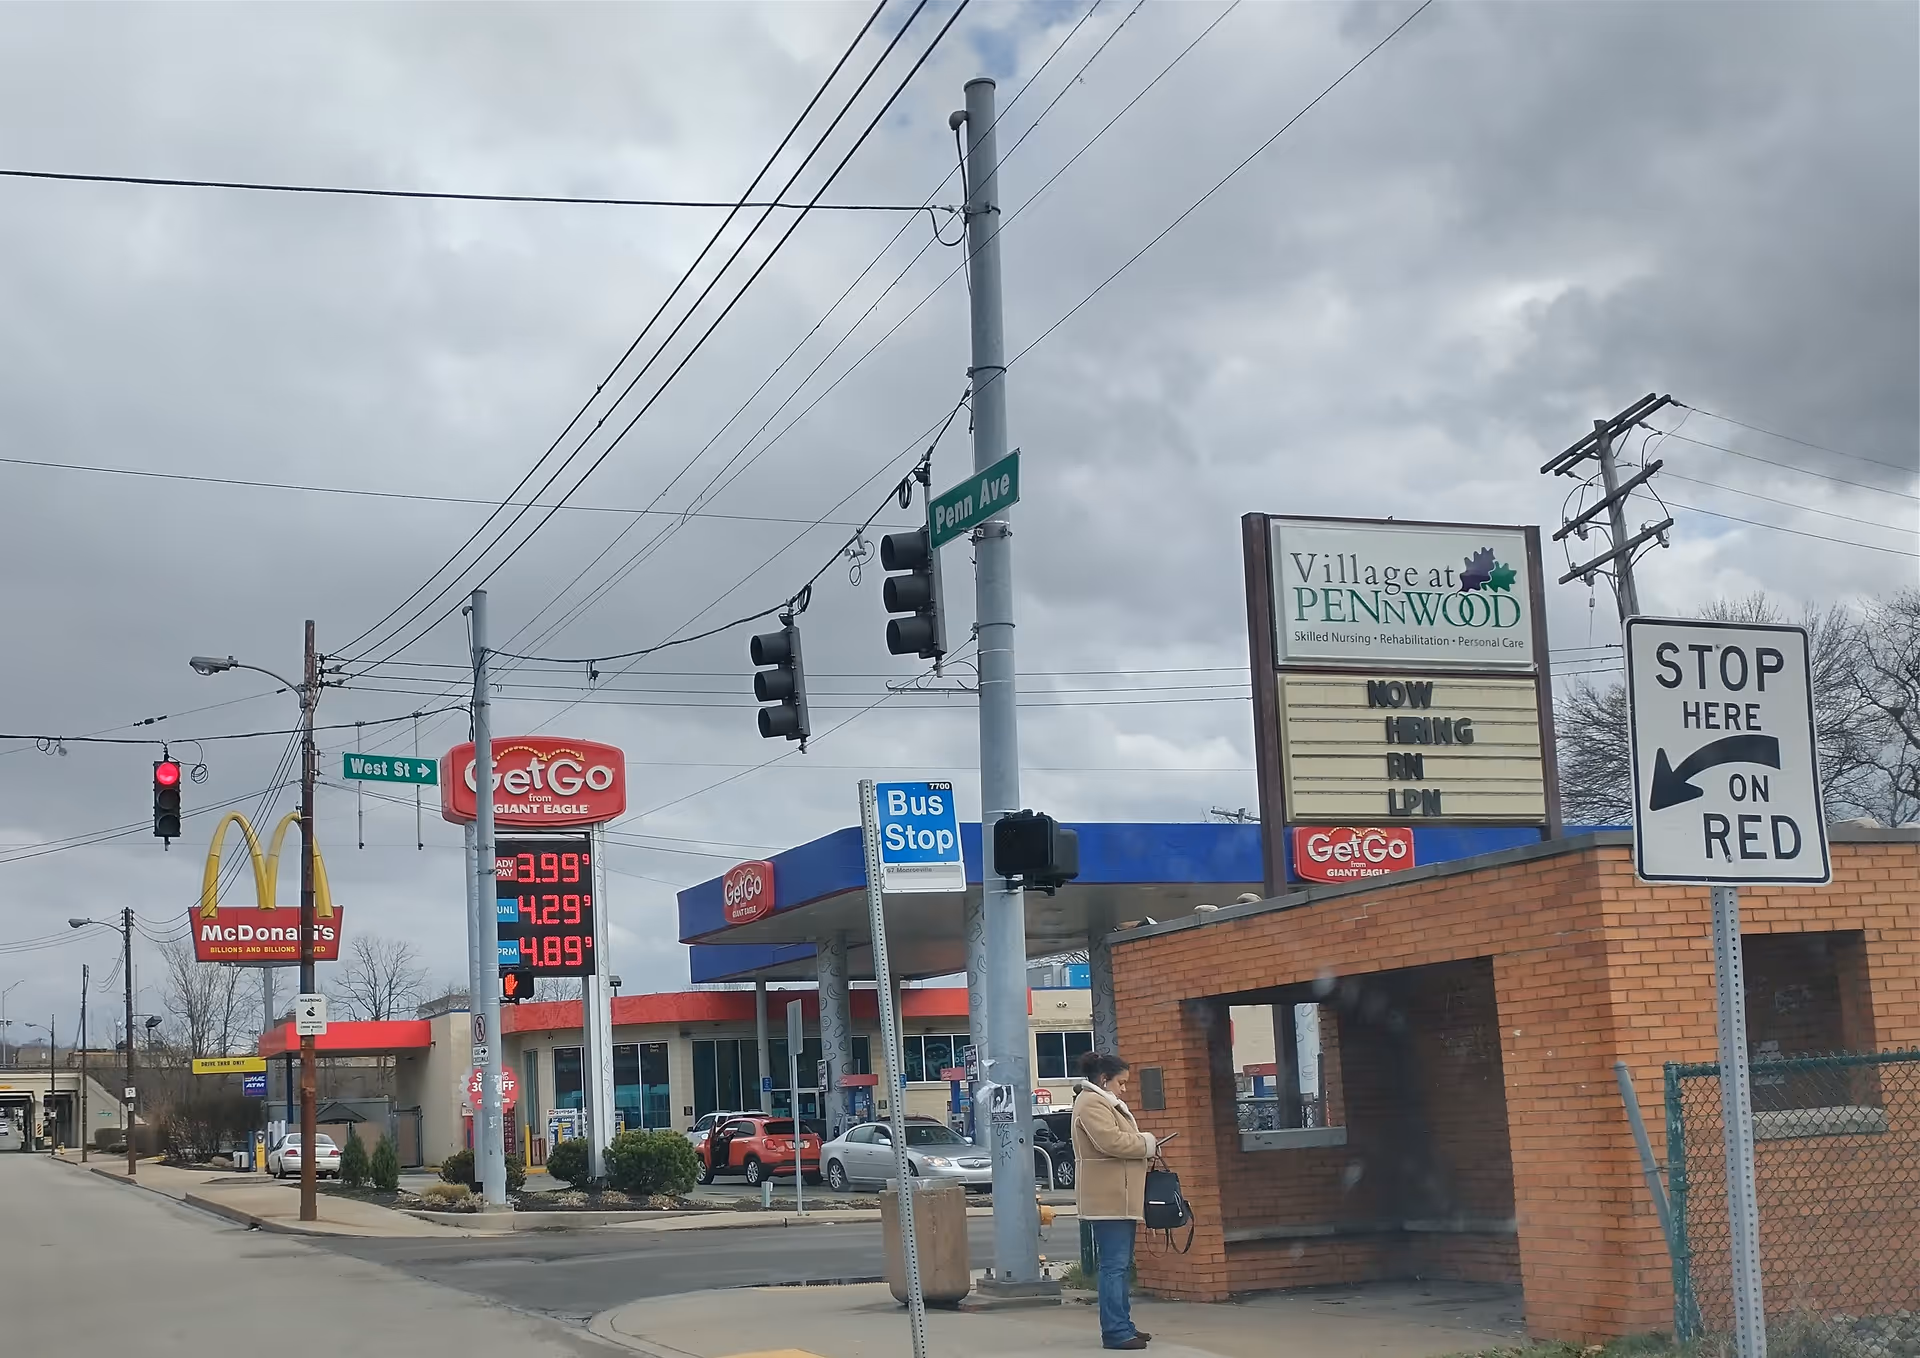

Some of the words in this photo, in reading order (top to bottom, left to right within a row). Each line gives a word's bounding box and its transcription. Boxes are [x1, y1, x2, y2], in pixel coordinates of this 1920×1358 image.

[936, 495, 973, 534] Penn
[979, 474, 1010, 509] Ave
[1290, 552, 1418, 595] Village
[1429, 565, 1456, 588] at
[1295, 631, 1328, 642] Skilled
[1331, 632, 1371, 646] Nursing
[1380, 633, 1449, 646] Rehabilitation
[1458, 636, 1500, 648] Personal
[1502, 637, 1524, 648] Care
[1655, 641, 1785, 692] STOP
[1367, 680, 1433, 709] NOW
[1682, 700, 1762, 731] HERE
[350, 757, 388, 776] West
[394, 761, 410, 777] St
[464, 757, 613, 796] GetGo
[1386, 752, 1424, 781] RN
[528, 793, 552, 802] from
[1388, 788, 1441, 816] LPN
[1729, 773, 1770, 803] ON
[494, 804, 540, 814] GIANT
[543, 804, 588, 814] EAGLE
[887, 789, 944, 816] Bus
[885, 823, 954, 855] Stop
[1307, 833, 1407, 863] GetGo
[1703, 813, 1801, 860] RED
[496, 860, 514, 868] ADV
[496, 869, 513, 877] PAY
[1326, 869, 1358, 877] GIANT
[725, 874, 762, 906] GetGo
[497, 906, 514, 914] UNL
[498, 948, 517, 956] PRM
[503, 1081, 515, 1091] FF
